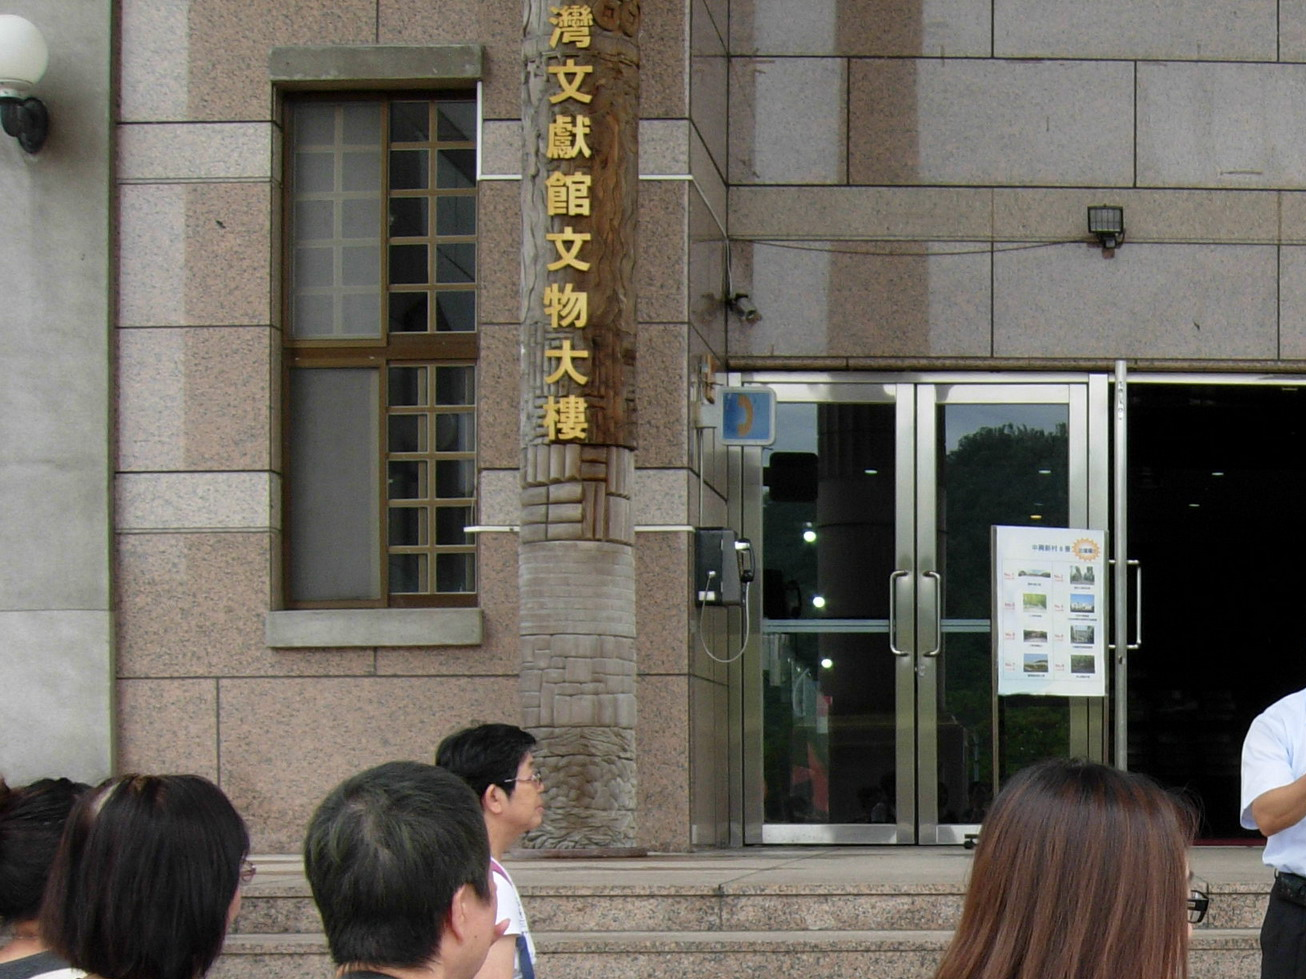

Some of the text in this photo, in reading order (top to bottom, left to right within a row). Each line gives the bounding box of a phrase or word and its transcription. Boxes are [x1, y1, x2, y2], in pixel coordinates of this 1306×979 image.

[543, 4, 594, 442] 灣文獻館文物大樓
